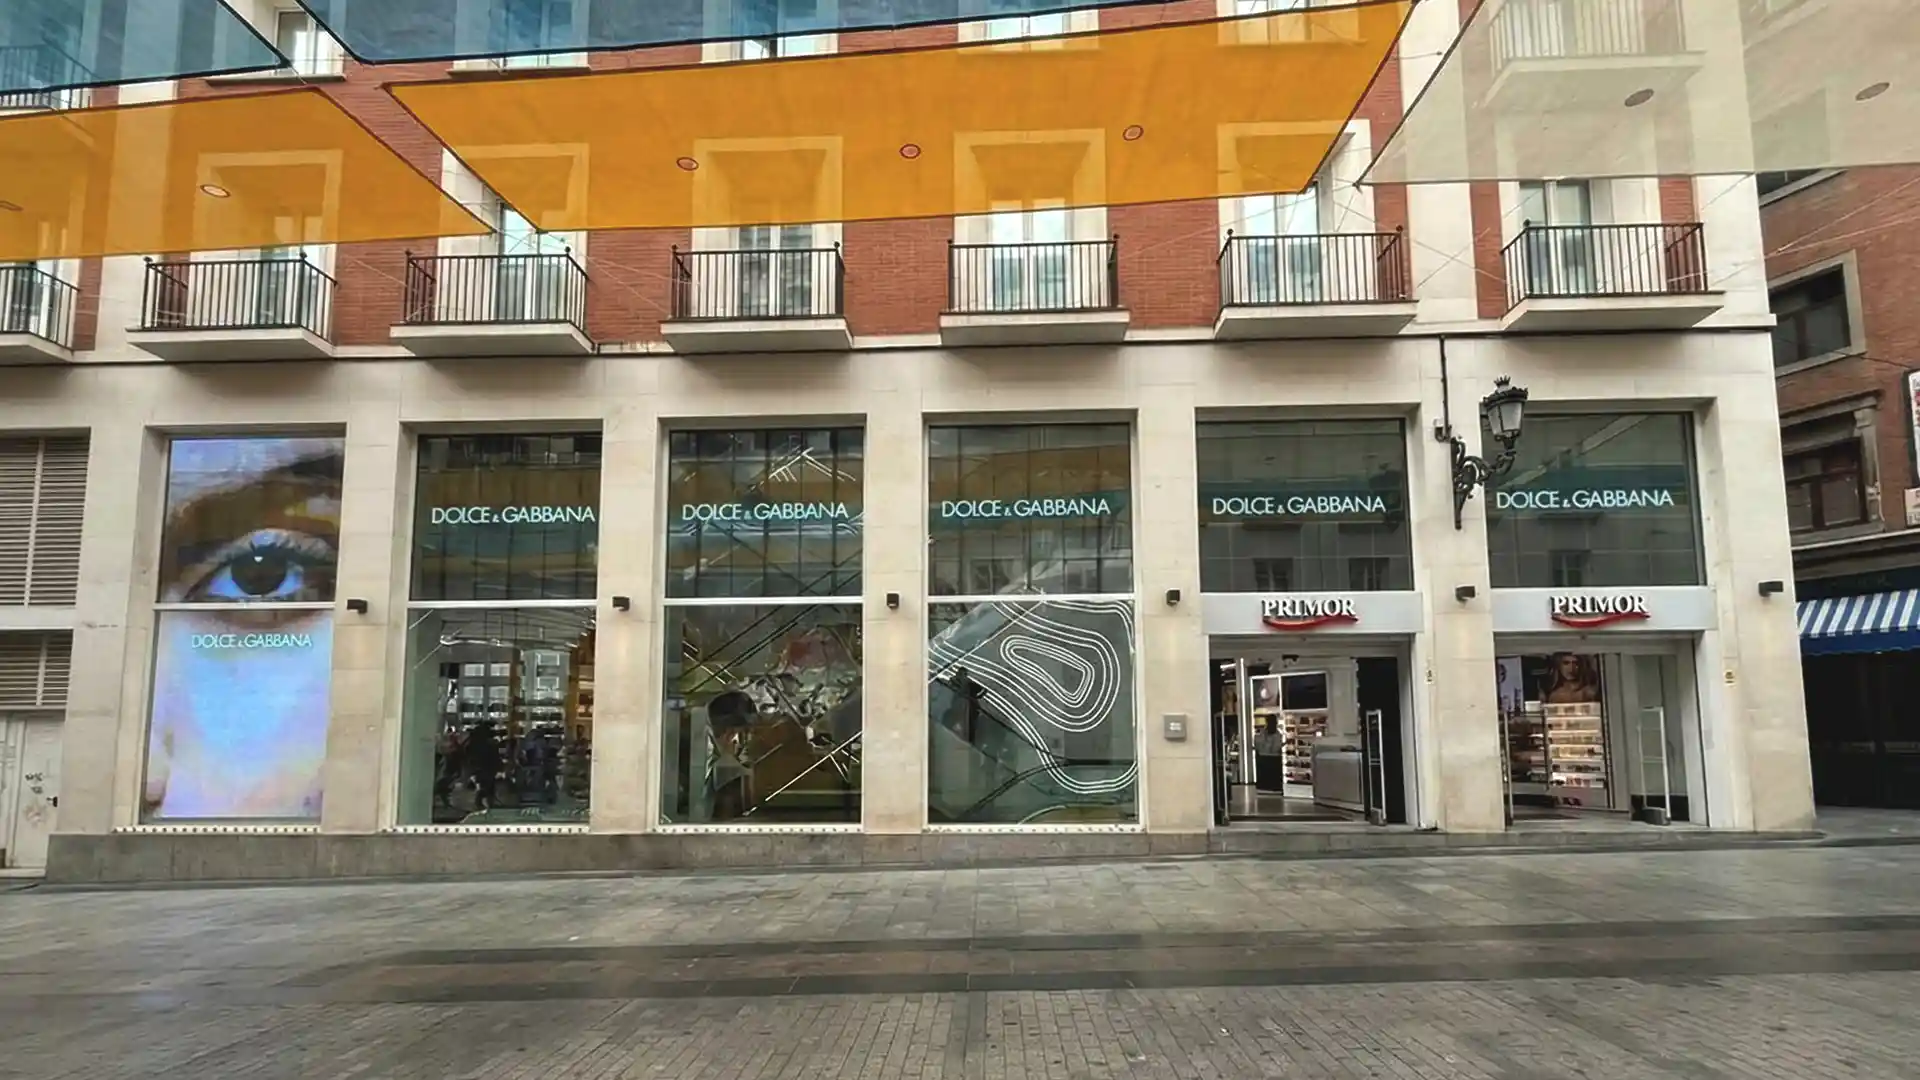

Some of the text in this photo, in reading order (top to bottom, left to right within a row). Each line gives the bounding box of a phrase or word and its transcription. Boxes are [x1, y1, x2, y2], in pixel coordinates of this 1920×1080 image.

[941, 498, 1111, 517] DOLCE & GABBANA
[1212, 496, 1386, 515] DOLCE & GABBANA
[1496, 489, 1675, 509] DOLCE & GABBANA
[432, 506, 596, 524] DOLCE & GABBANA
[682, 502, 849, 521] DOLCE & GABBANA
[1262, 598, 1357, 617] PRIMOR
[1551, 595, 1648, 614] PRIMOR
[191, 634, 236, 648] DOLCE
[244, 633, 312, 648] GABBANA
